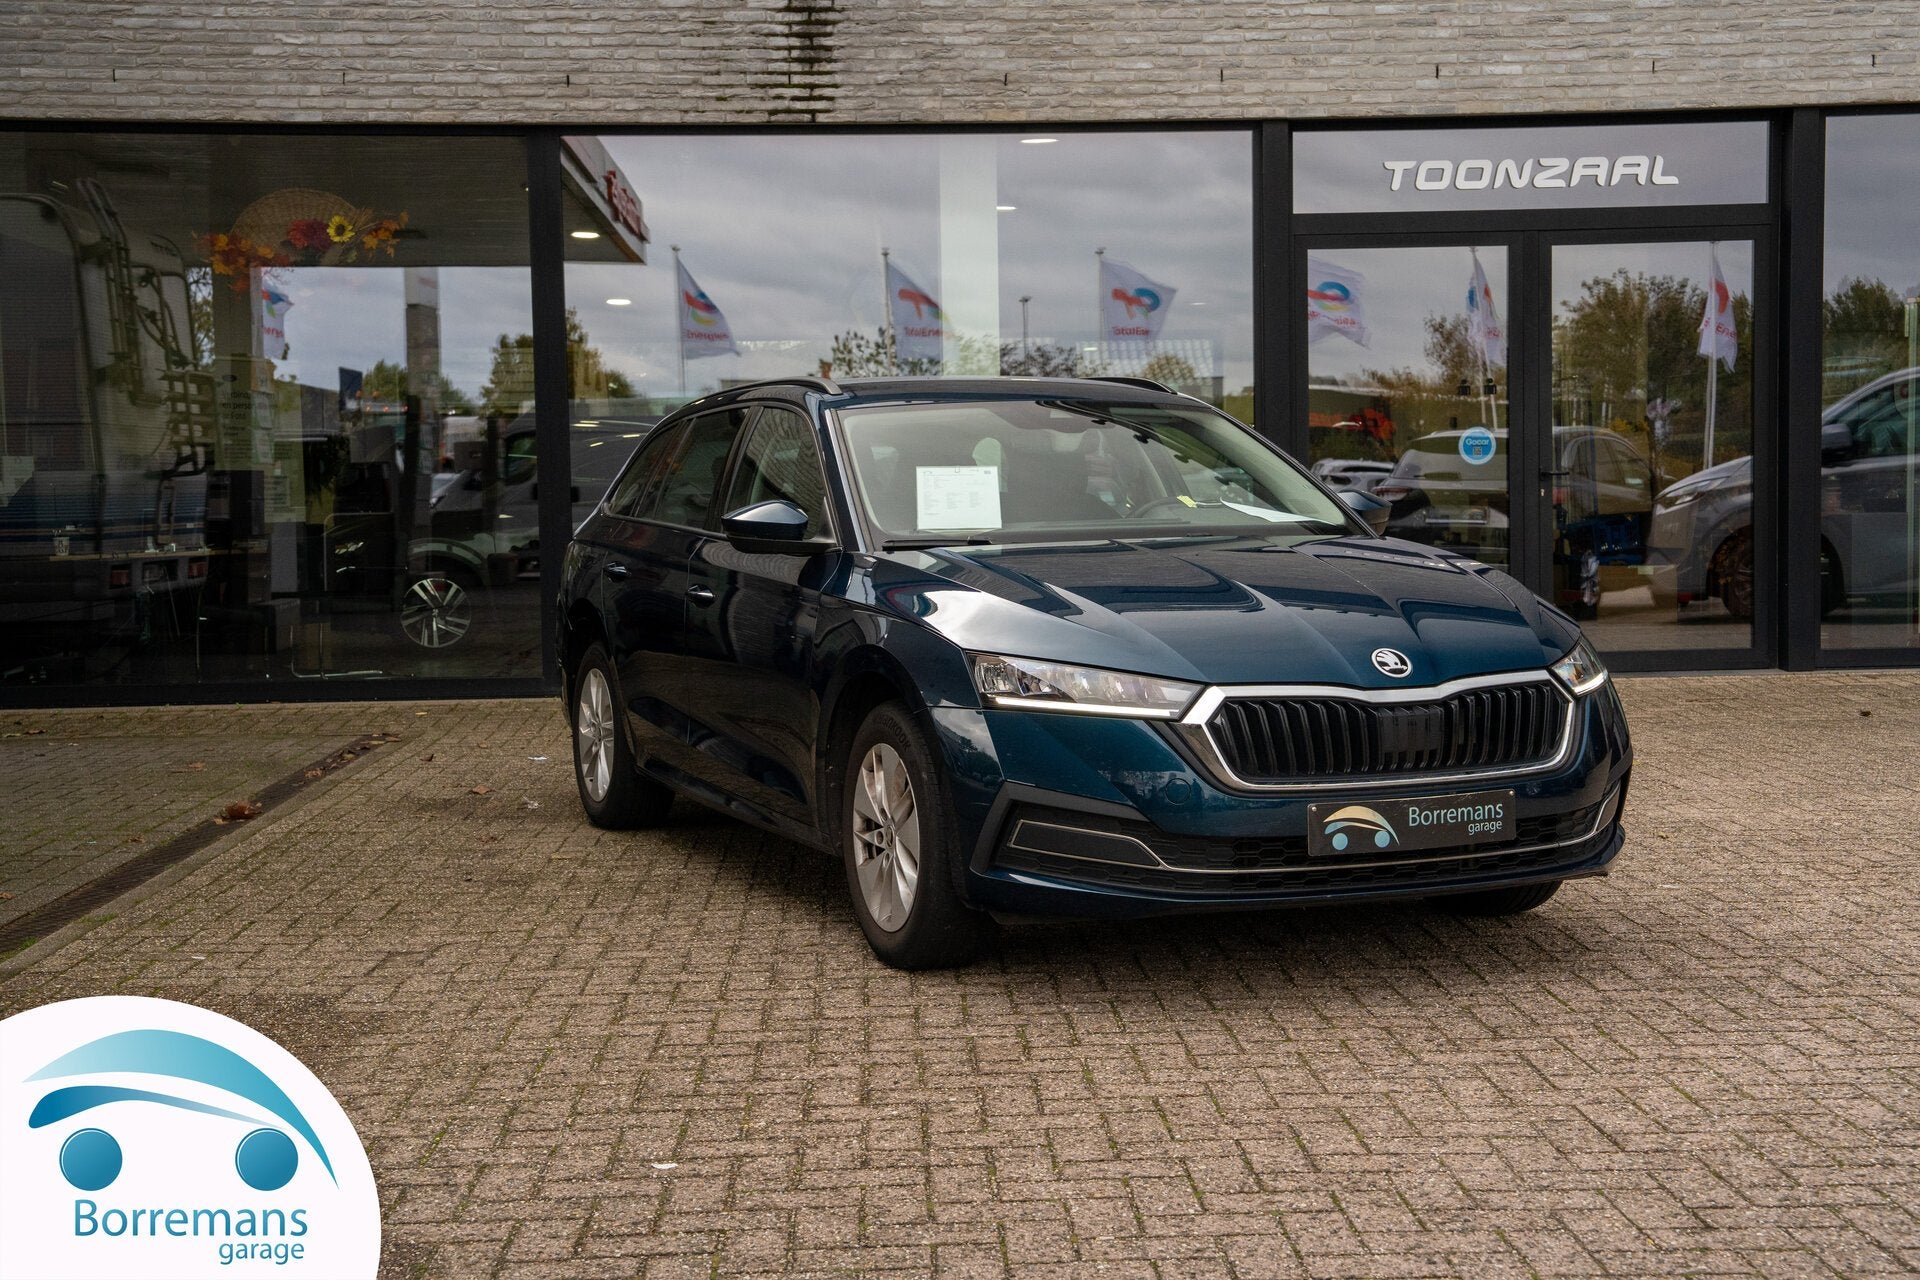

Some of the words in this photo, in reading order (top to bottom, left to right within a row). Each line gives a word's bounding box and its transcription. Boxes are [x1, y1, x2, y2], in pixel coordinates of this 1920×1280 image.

[1383, 155, 1680, 192] TOONZAAL
[1465, 438, 1490, 446] Gocar
[1408, 802, 1504, 827] Borremans
[1467, 820, 1503, 836] garage
